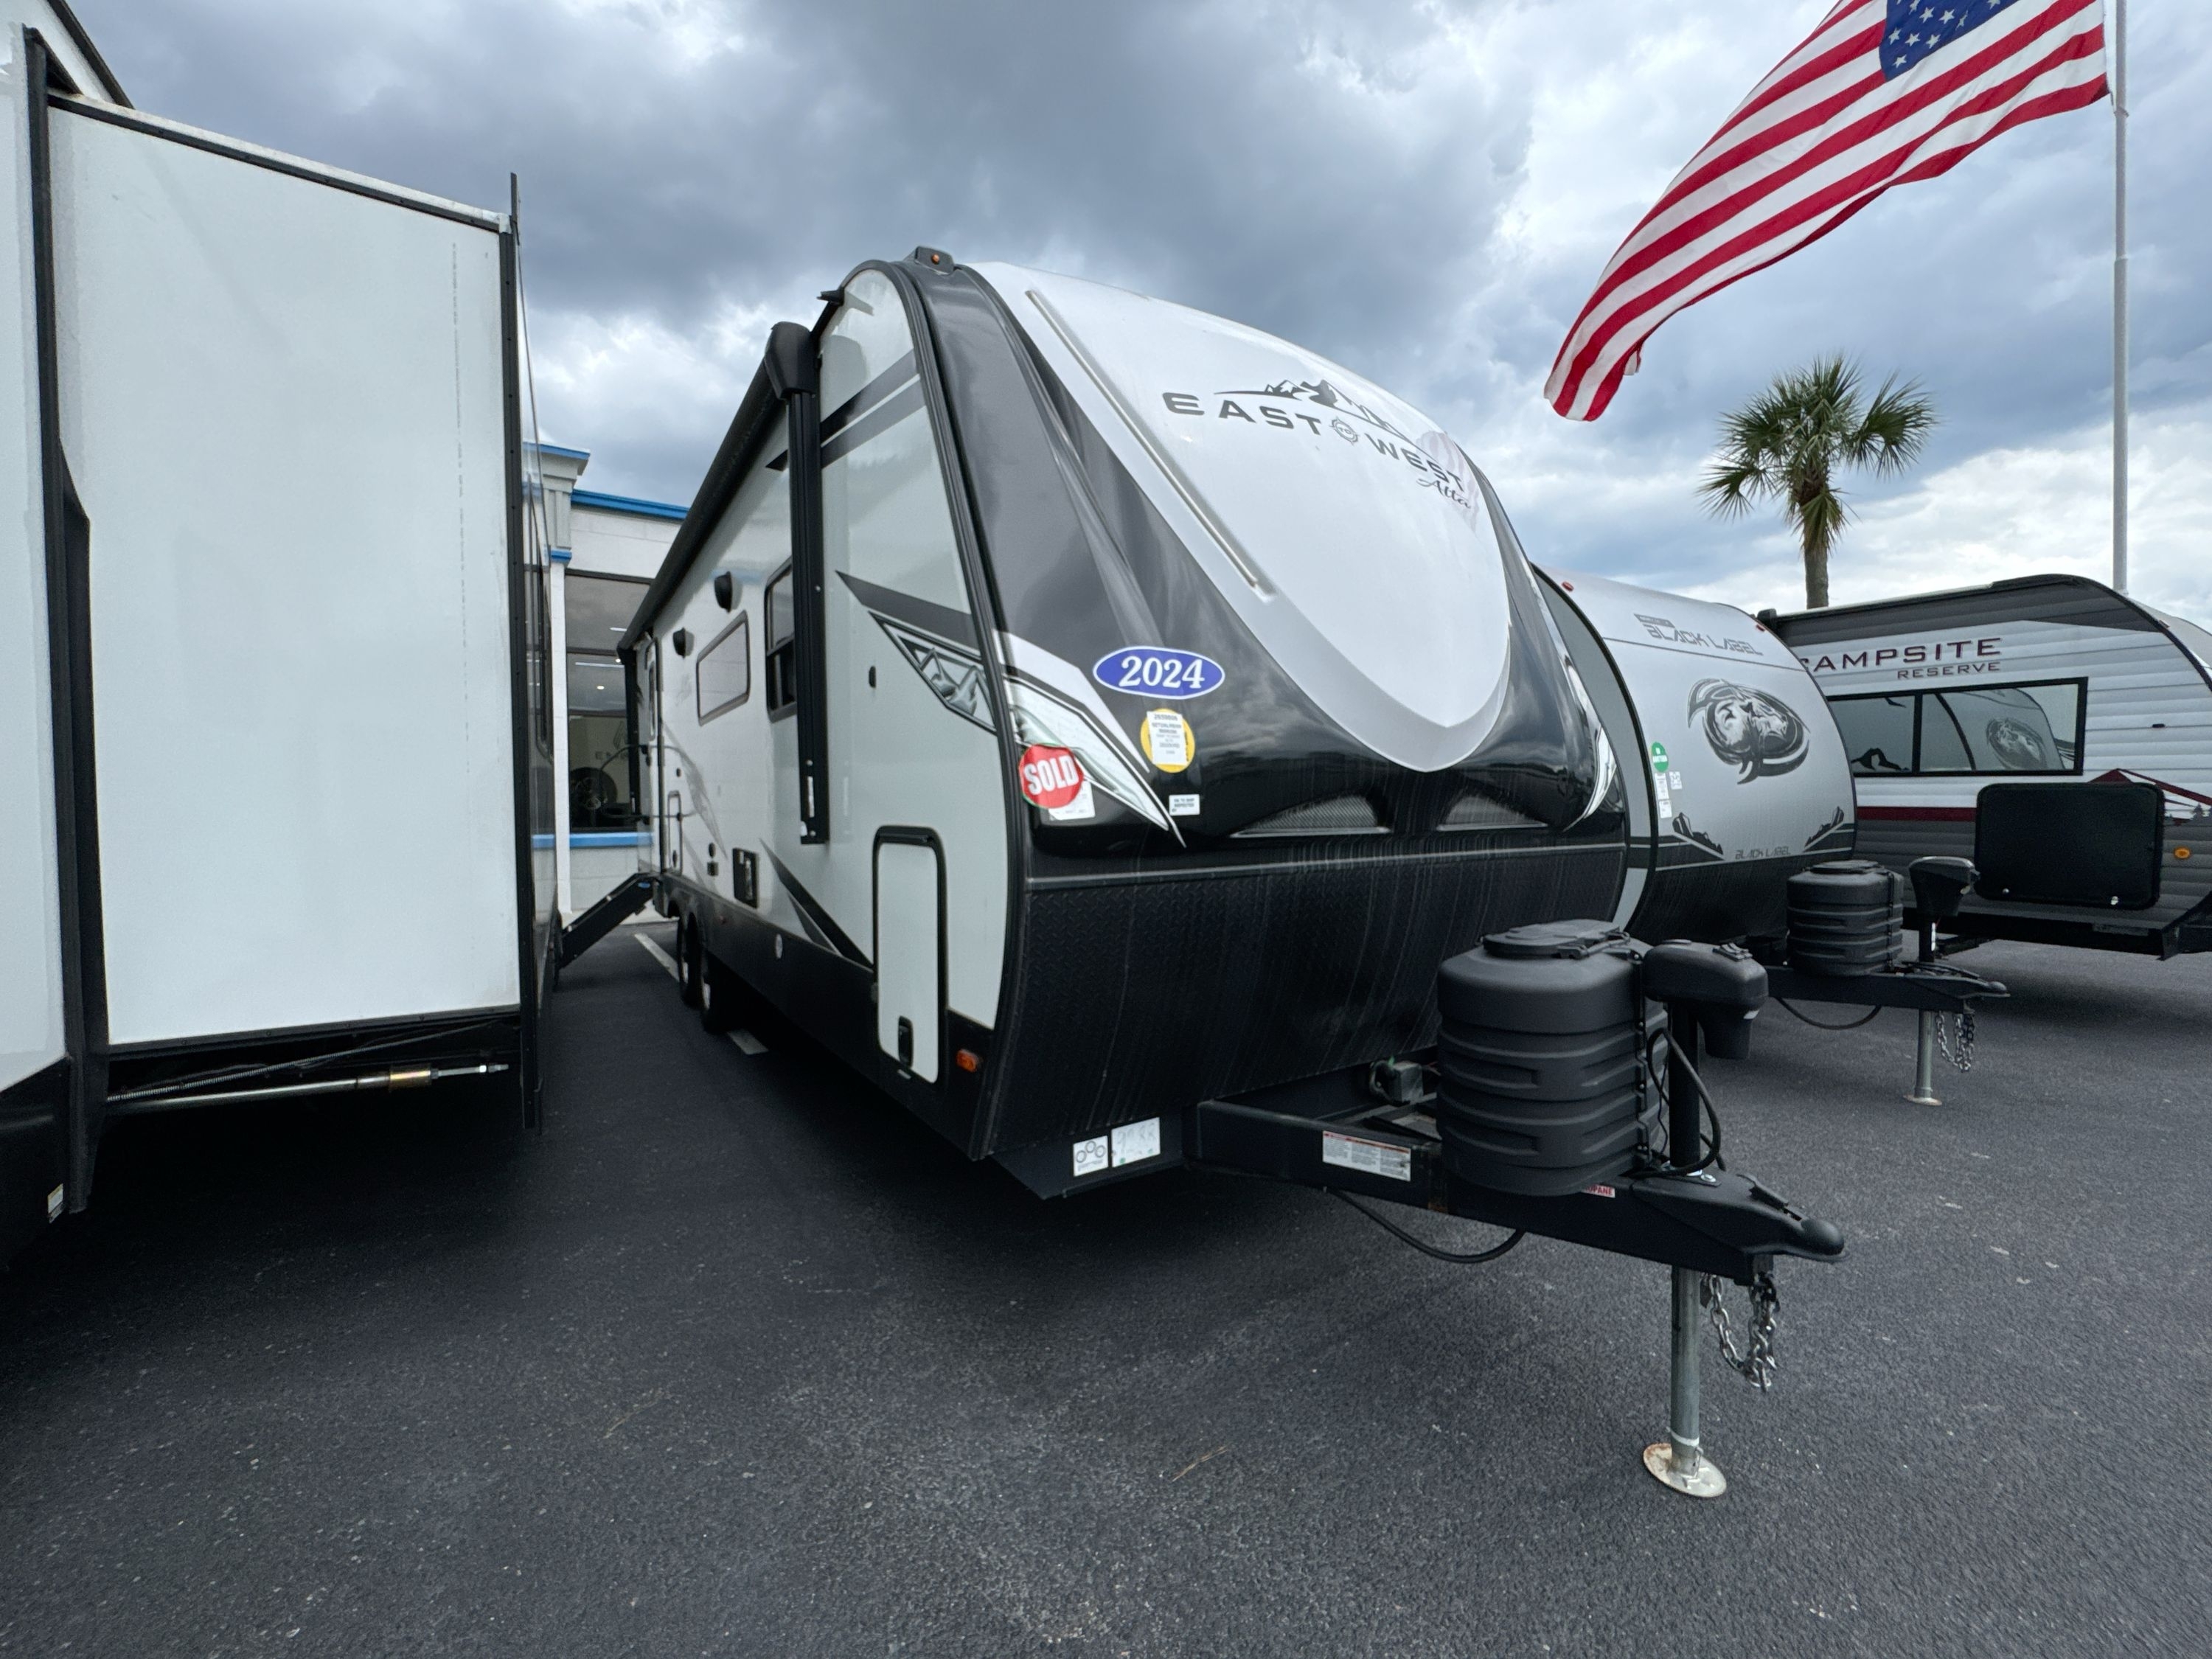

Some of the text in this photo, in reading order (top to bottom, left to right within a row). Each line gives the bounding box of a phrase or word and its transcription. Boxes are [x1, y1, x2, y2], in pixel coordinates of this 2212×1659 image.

[1162, 392, 1322, 436] EAST
[1364, 432, 1464, 493] WEST
[1416, 478, 1472, 509] Alta
[1642, 623, 1764, 656] BLACK LABEL
[1118, 655, 1206, 689] 2024
[1896, 661, 2000, 680] RESERVE
[1023, 754, 1079, 796] SOLD
